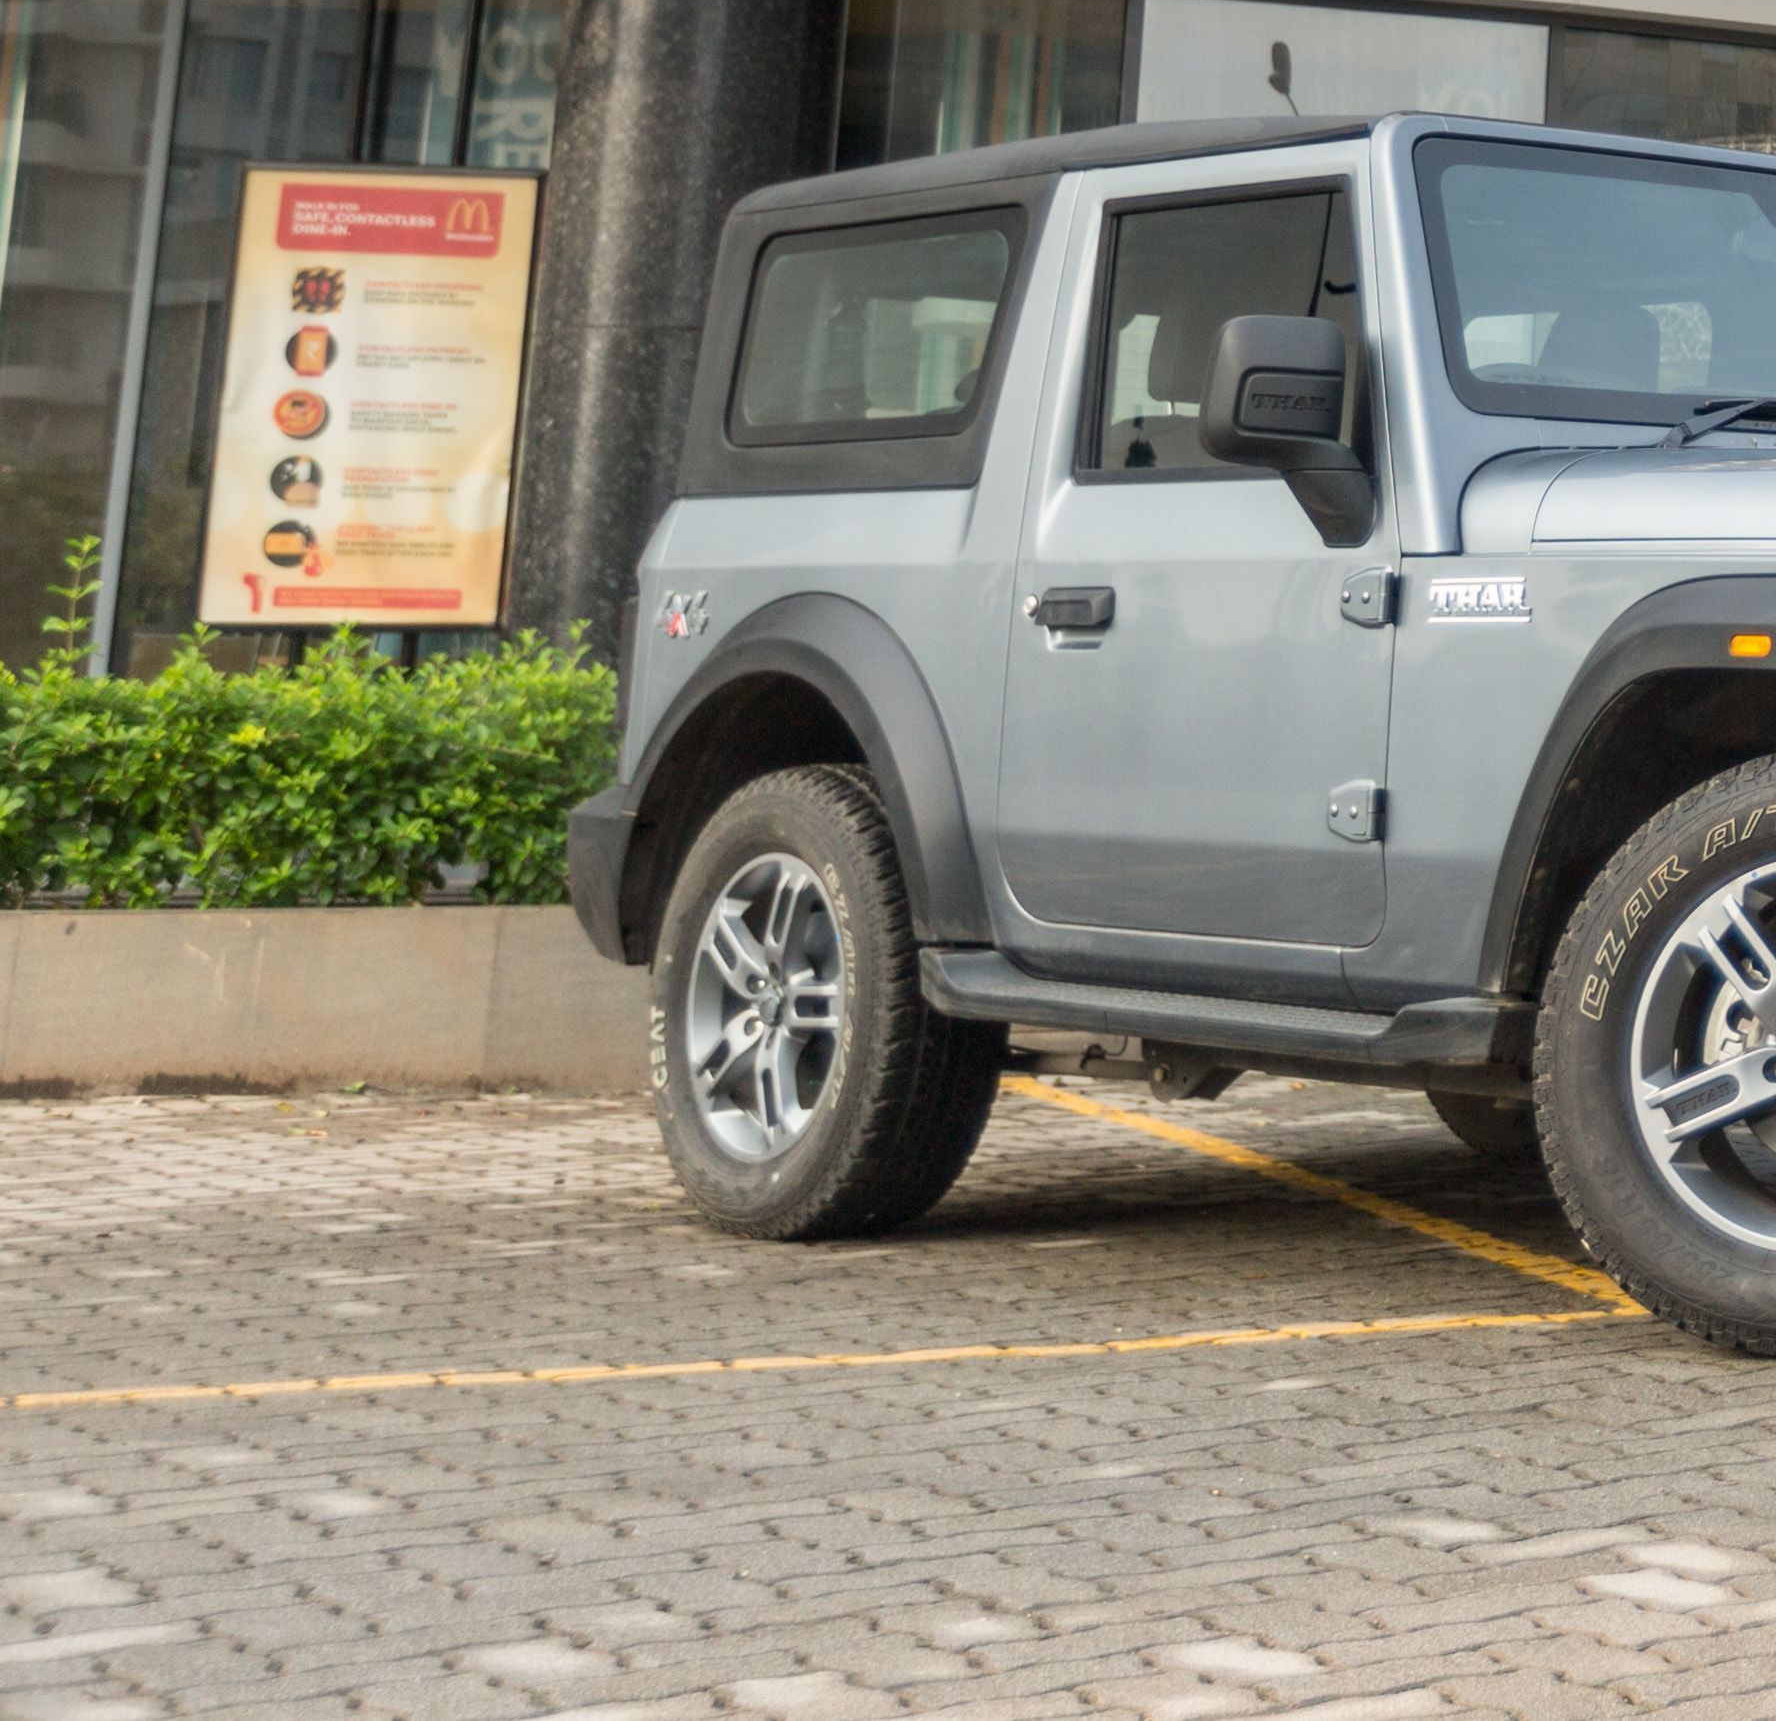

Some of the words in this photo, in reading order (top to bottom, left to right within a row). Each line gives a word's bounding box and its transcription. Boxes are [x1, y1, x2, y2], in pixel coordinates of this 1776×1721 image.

[334, 214, 437, 228] CONTACTLESS
[1429, 583, 1532, 616] THAR
[1580, 855, 1690, 1020] CZAR
[650, 1005, 668, 1088] CEAT
